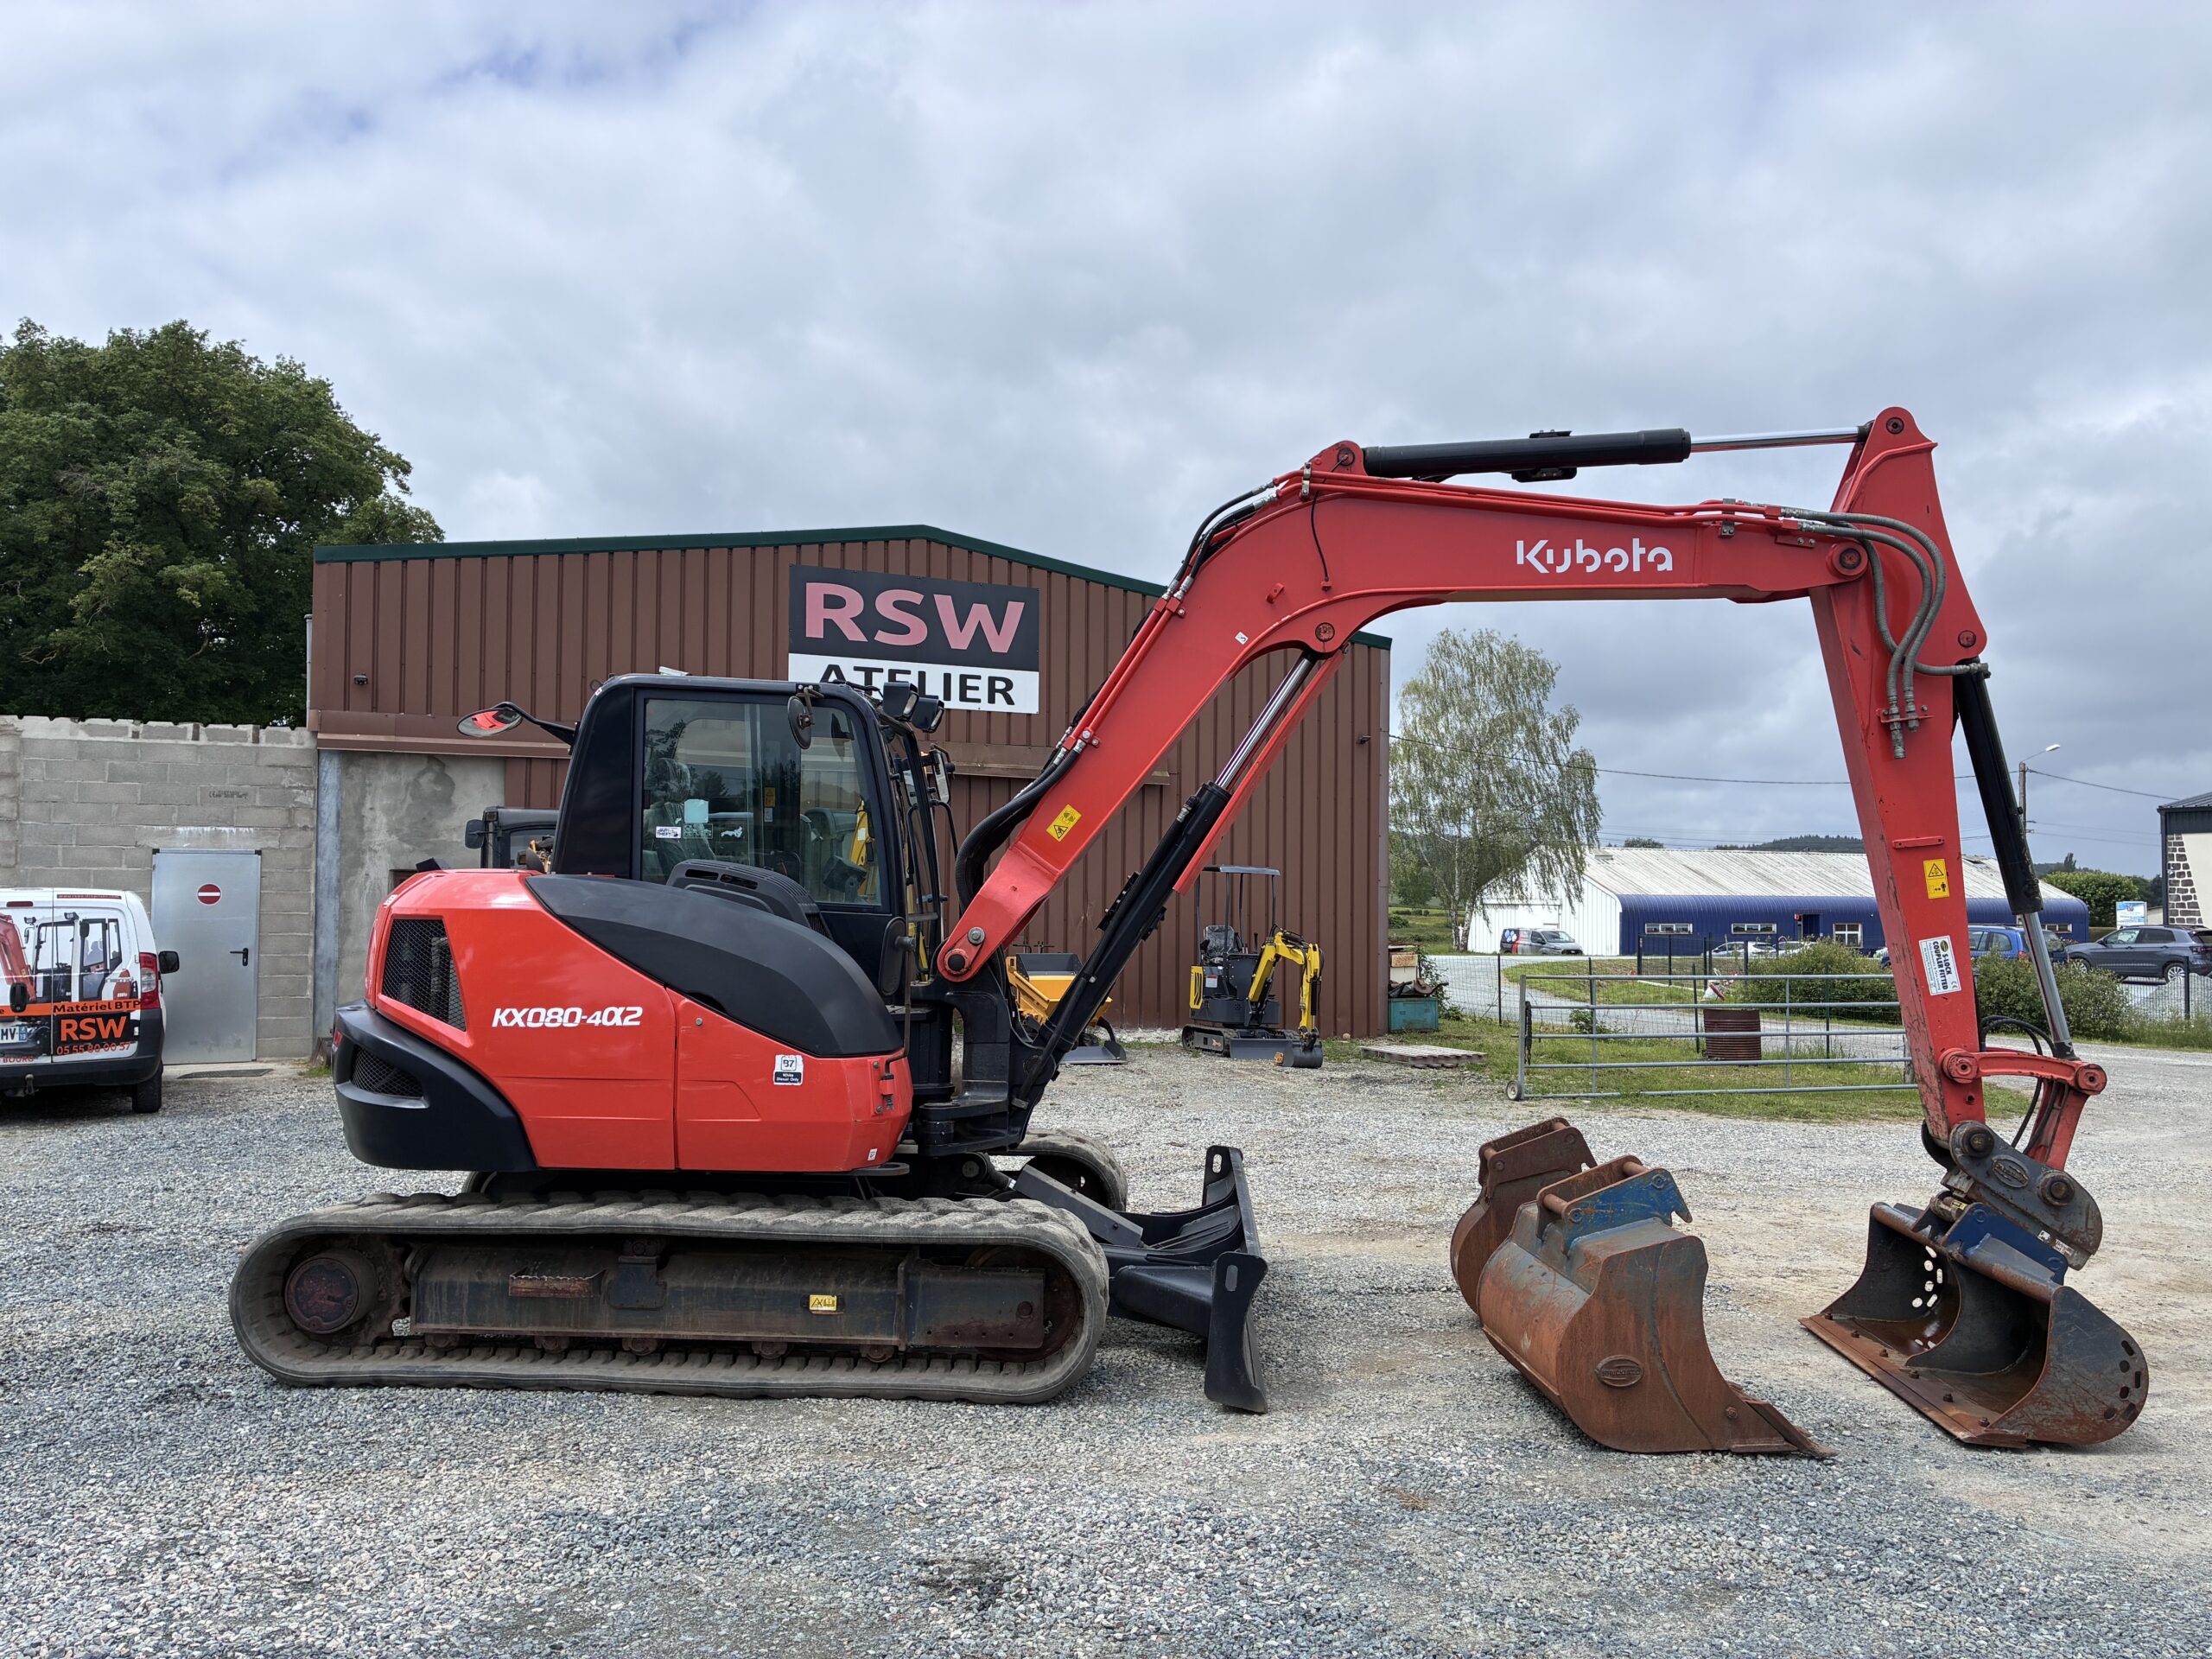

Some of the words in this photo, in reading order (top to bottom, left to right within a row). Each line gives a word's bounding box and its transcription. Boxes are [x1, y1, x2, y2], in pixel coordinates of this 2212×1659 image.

[1516, 537, 1673, 574] Kubota
[805, 582, 1026, 653] RSW
[1933, 941, 1943, 969] COUPLER
[1939, 969, 1948, 990] FITTED
[1942, 954, 1952, 975] S-LOCK
[53, 1002, 111, 1013] Matériel
[115, 1001, 141, 1009] BTP
[60, 1016, 127, 1041] RSW
[56, 1046, 69, 1055] 05
[72, 1045, 85, 1053] 55
[87, 1043, 100, 1052] 80
[104, 1042, 117, 1052] 00
